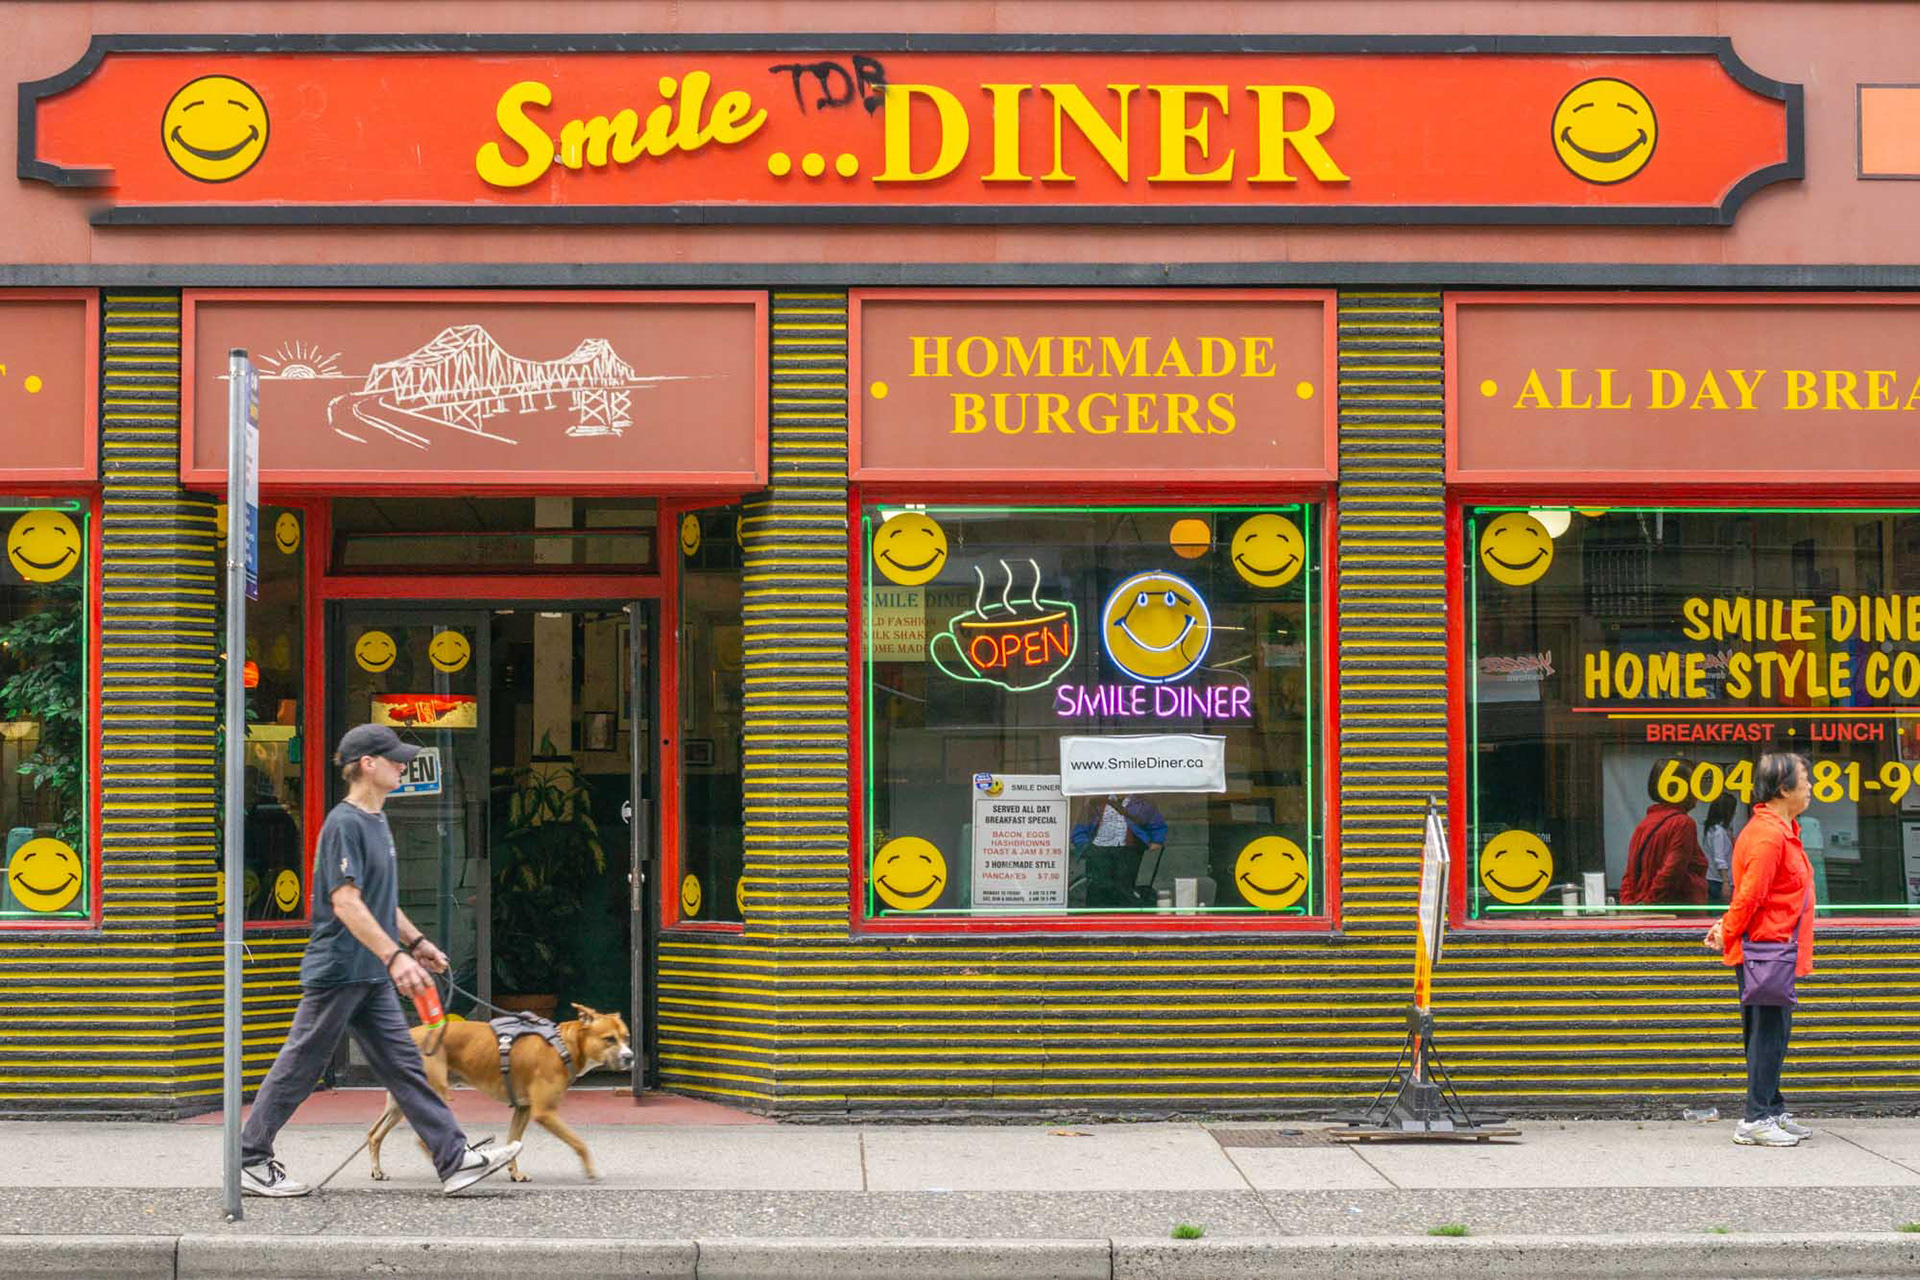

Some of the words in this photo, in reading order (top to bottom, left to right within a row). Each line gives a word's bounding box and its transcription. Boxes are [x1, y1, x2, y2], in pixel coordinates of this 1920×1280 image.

[475, 70, 768, 187] Smile
[909, 336, 1277, 377] HOMEMADE
[1513, 368, 1633, 409] ALL
[1647, 368, 1767, 410] DAY
[950, 393, 1237, 435] BURGERS
[863, 592, 919, 608] SMILE
[1683, 596, 1816, 642] SMILE
[970, 621, 1070, 668] OPEN
[1585, 650, 1706, 699] HOME
[1726, 649, 1851, 698] STYLE
[1866, 651, 1920, 699] CO
[1057, 684, 1146, 717] SMILE
[1155, 684, 1252, 718] DINER
[1646, 723, 1775, 742] BREAKFAST
[1810, 723, 1885, 741] LUNCH
[1071, 756, 1204, 771] www.SmileDiner.ca
[985, 816, 1025, 824] BREAKFAST
[1027, 816, 1058, 824] SPECIAL
[992, 805, 1020, 813] SERVED
[1022, 805, 1034, 813] ALL
[1036, 805, 1051, 813] DAY
[982, 872, 1027, 880] PANCAKES
